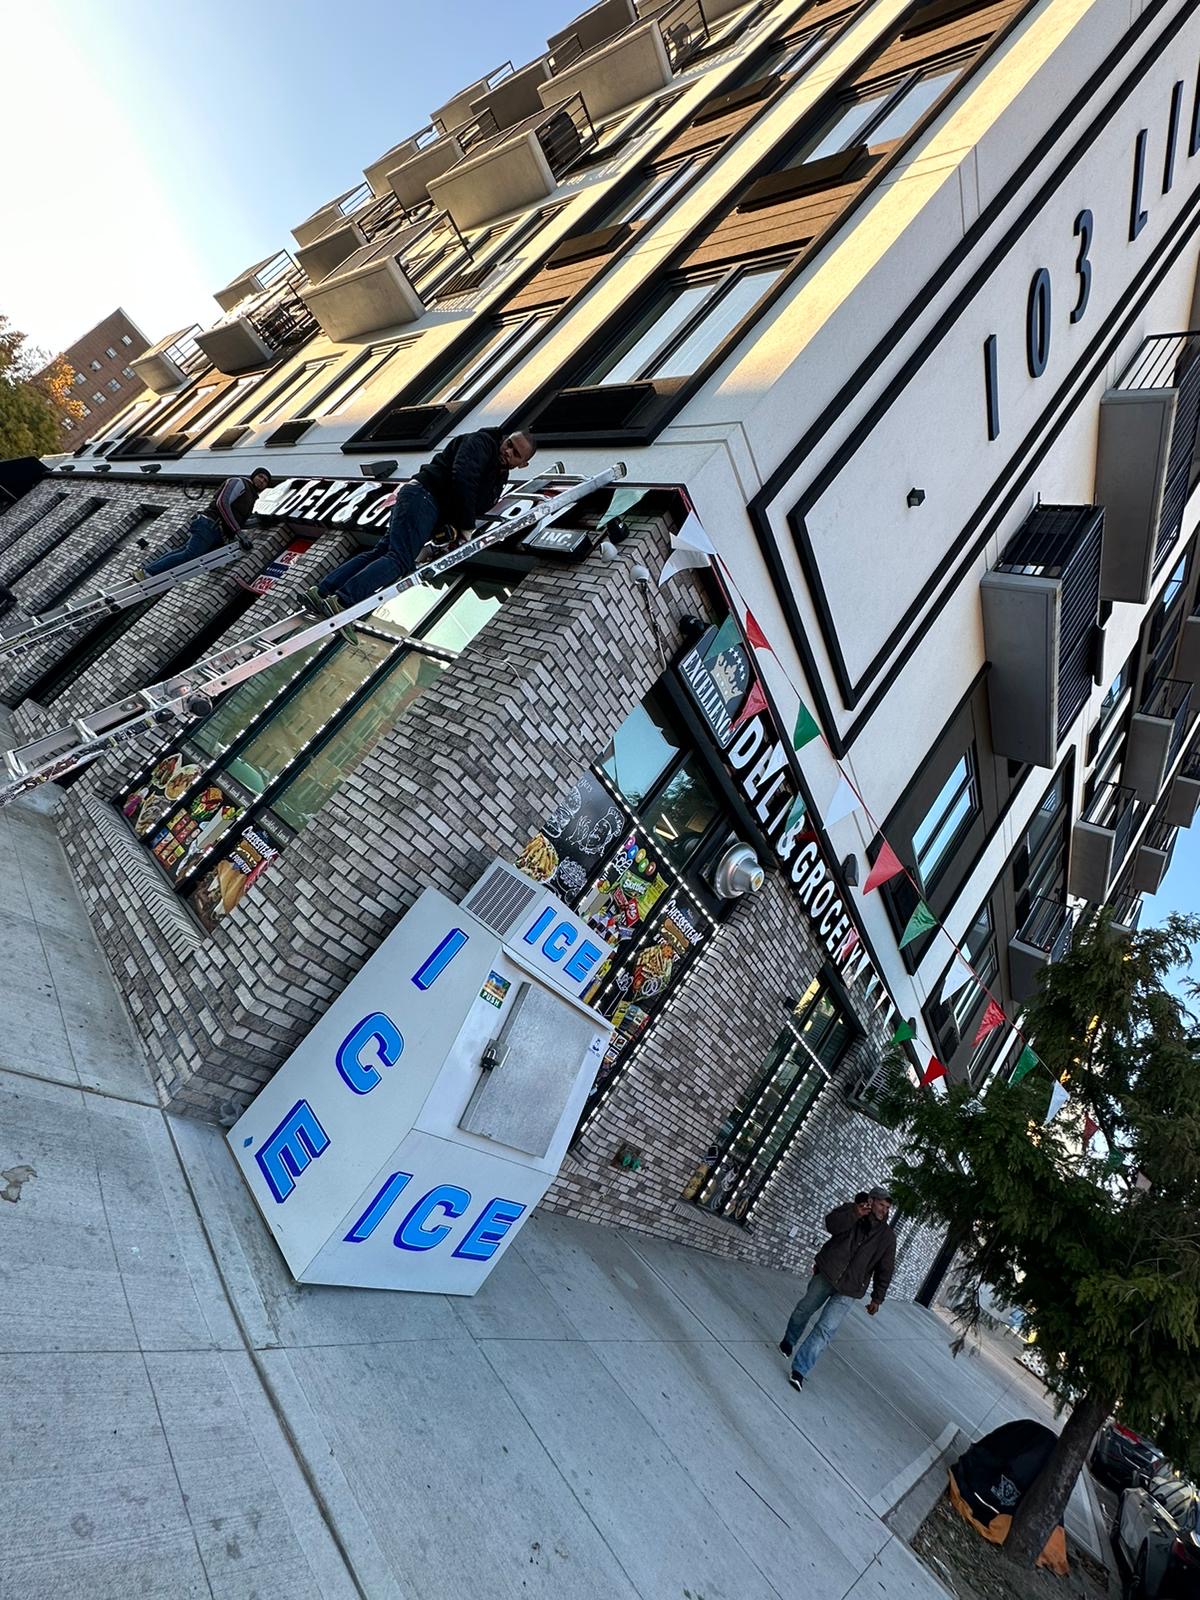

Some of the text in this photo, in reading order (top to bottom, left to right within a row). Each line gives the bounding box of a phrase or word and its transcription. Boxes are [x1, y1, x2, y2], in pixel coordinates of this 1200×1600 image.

[983, 60, 1200, 441] 103 LI
[540, 531, 572, 546] INC.
[682, 650, 736, 744] EXCELLENCE
[241, 825, 277, 860] CHEESESTEAK
[729, 714, 863, 975] DELI & GROCERY
[523, 905, 602, 983] ICE
[666, 900, 704, 945] CHEESESTEAK
[481, 991, 500, 1005] PUSH
[255, 928, 469, 1204] ICE
[342, 1170, 528, 1262] ICE
